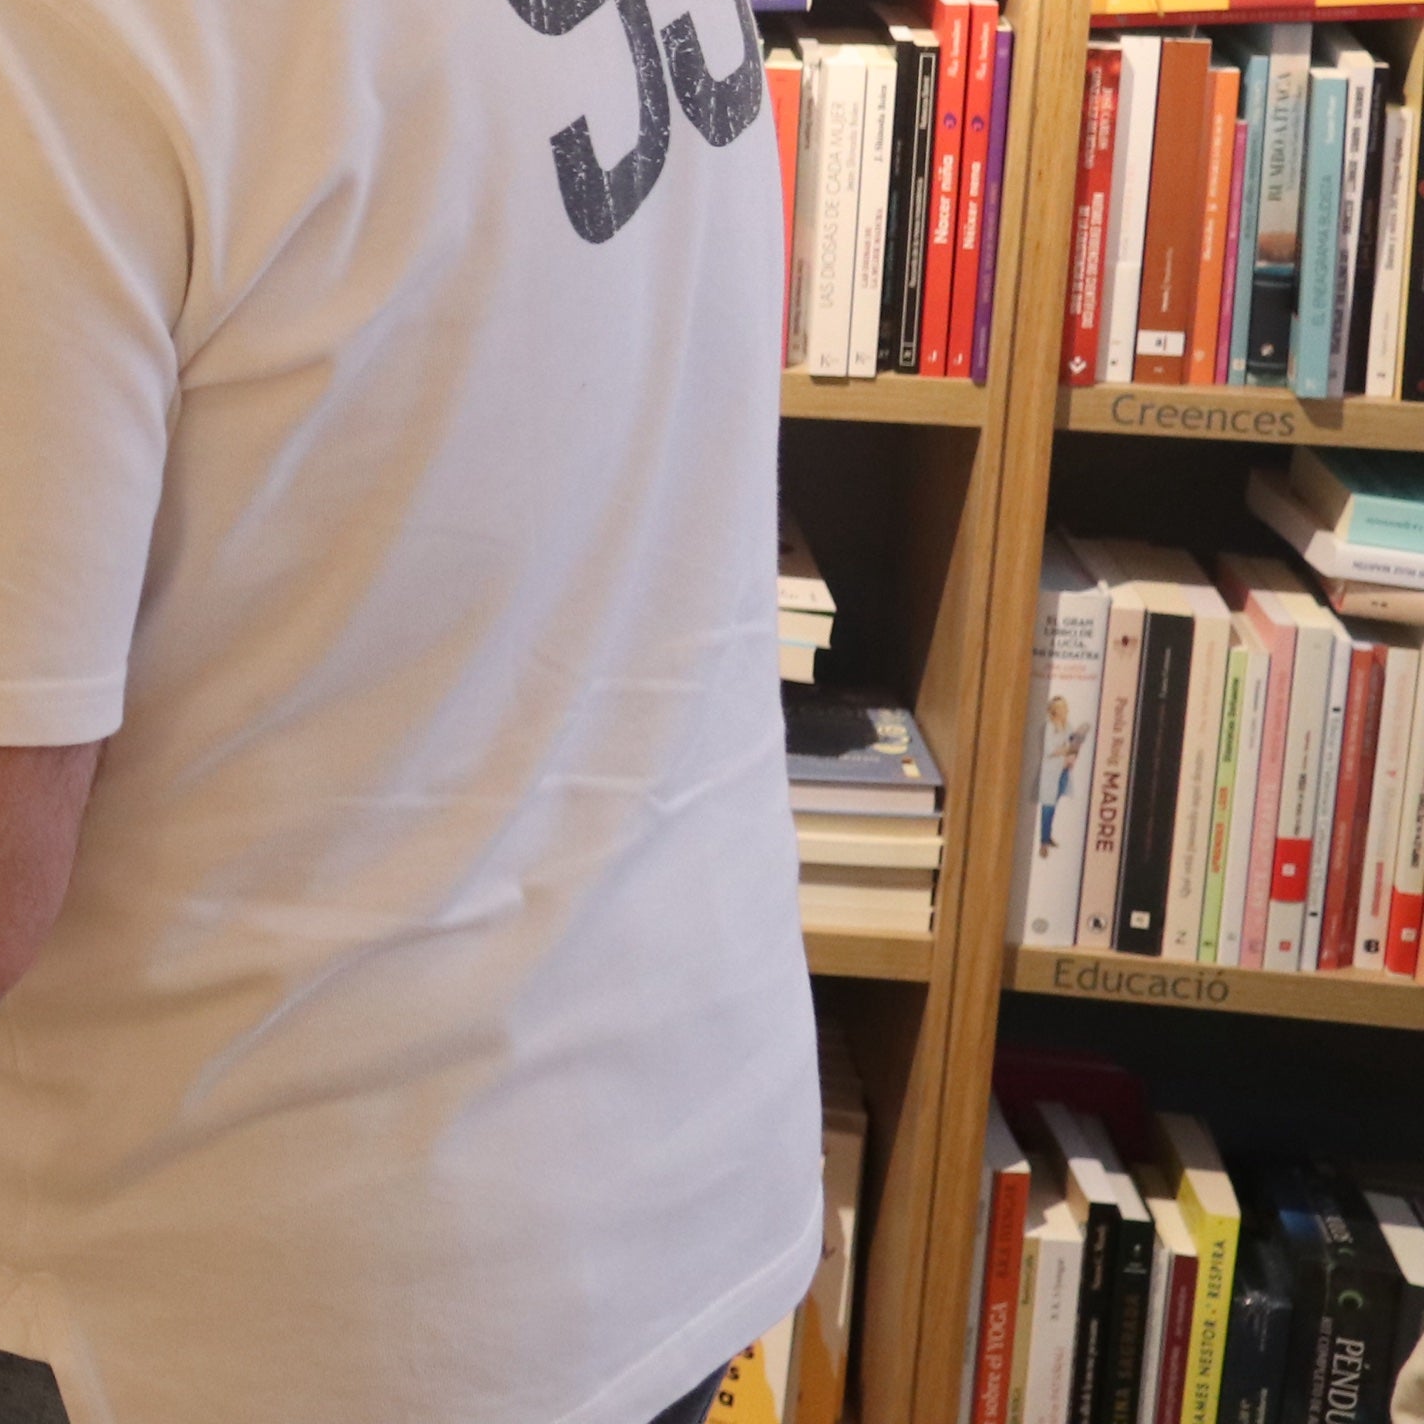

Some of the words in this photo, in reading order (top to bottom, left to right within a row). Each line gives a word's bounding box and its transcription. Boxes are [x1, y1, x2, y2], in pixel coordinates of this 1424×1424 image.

[1111, 394, 1296, 437] Creences
[1096, 770, 1121, 854] MADRE
[1053, 957, 1231, 1004] Educació
[1206, 1239, 1228, 1300] RESPIRA
[1199, 1319, 1217, 1377] NESTOR
